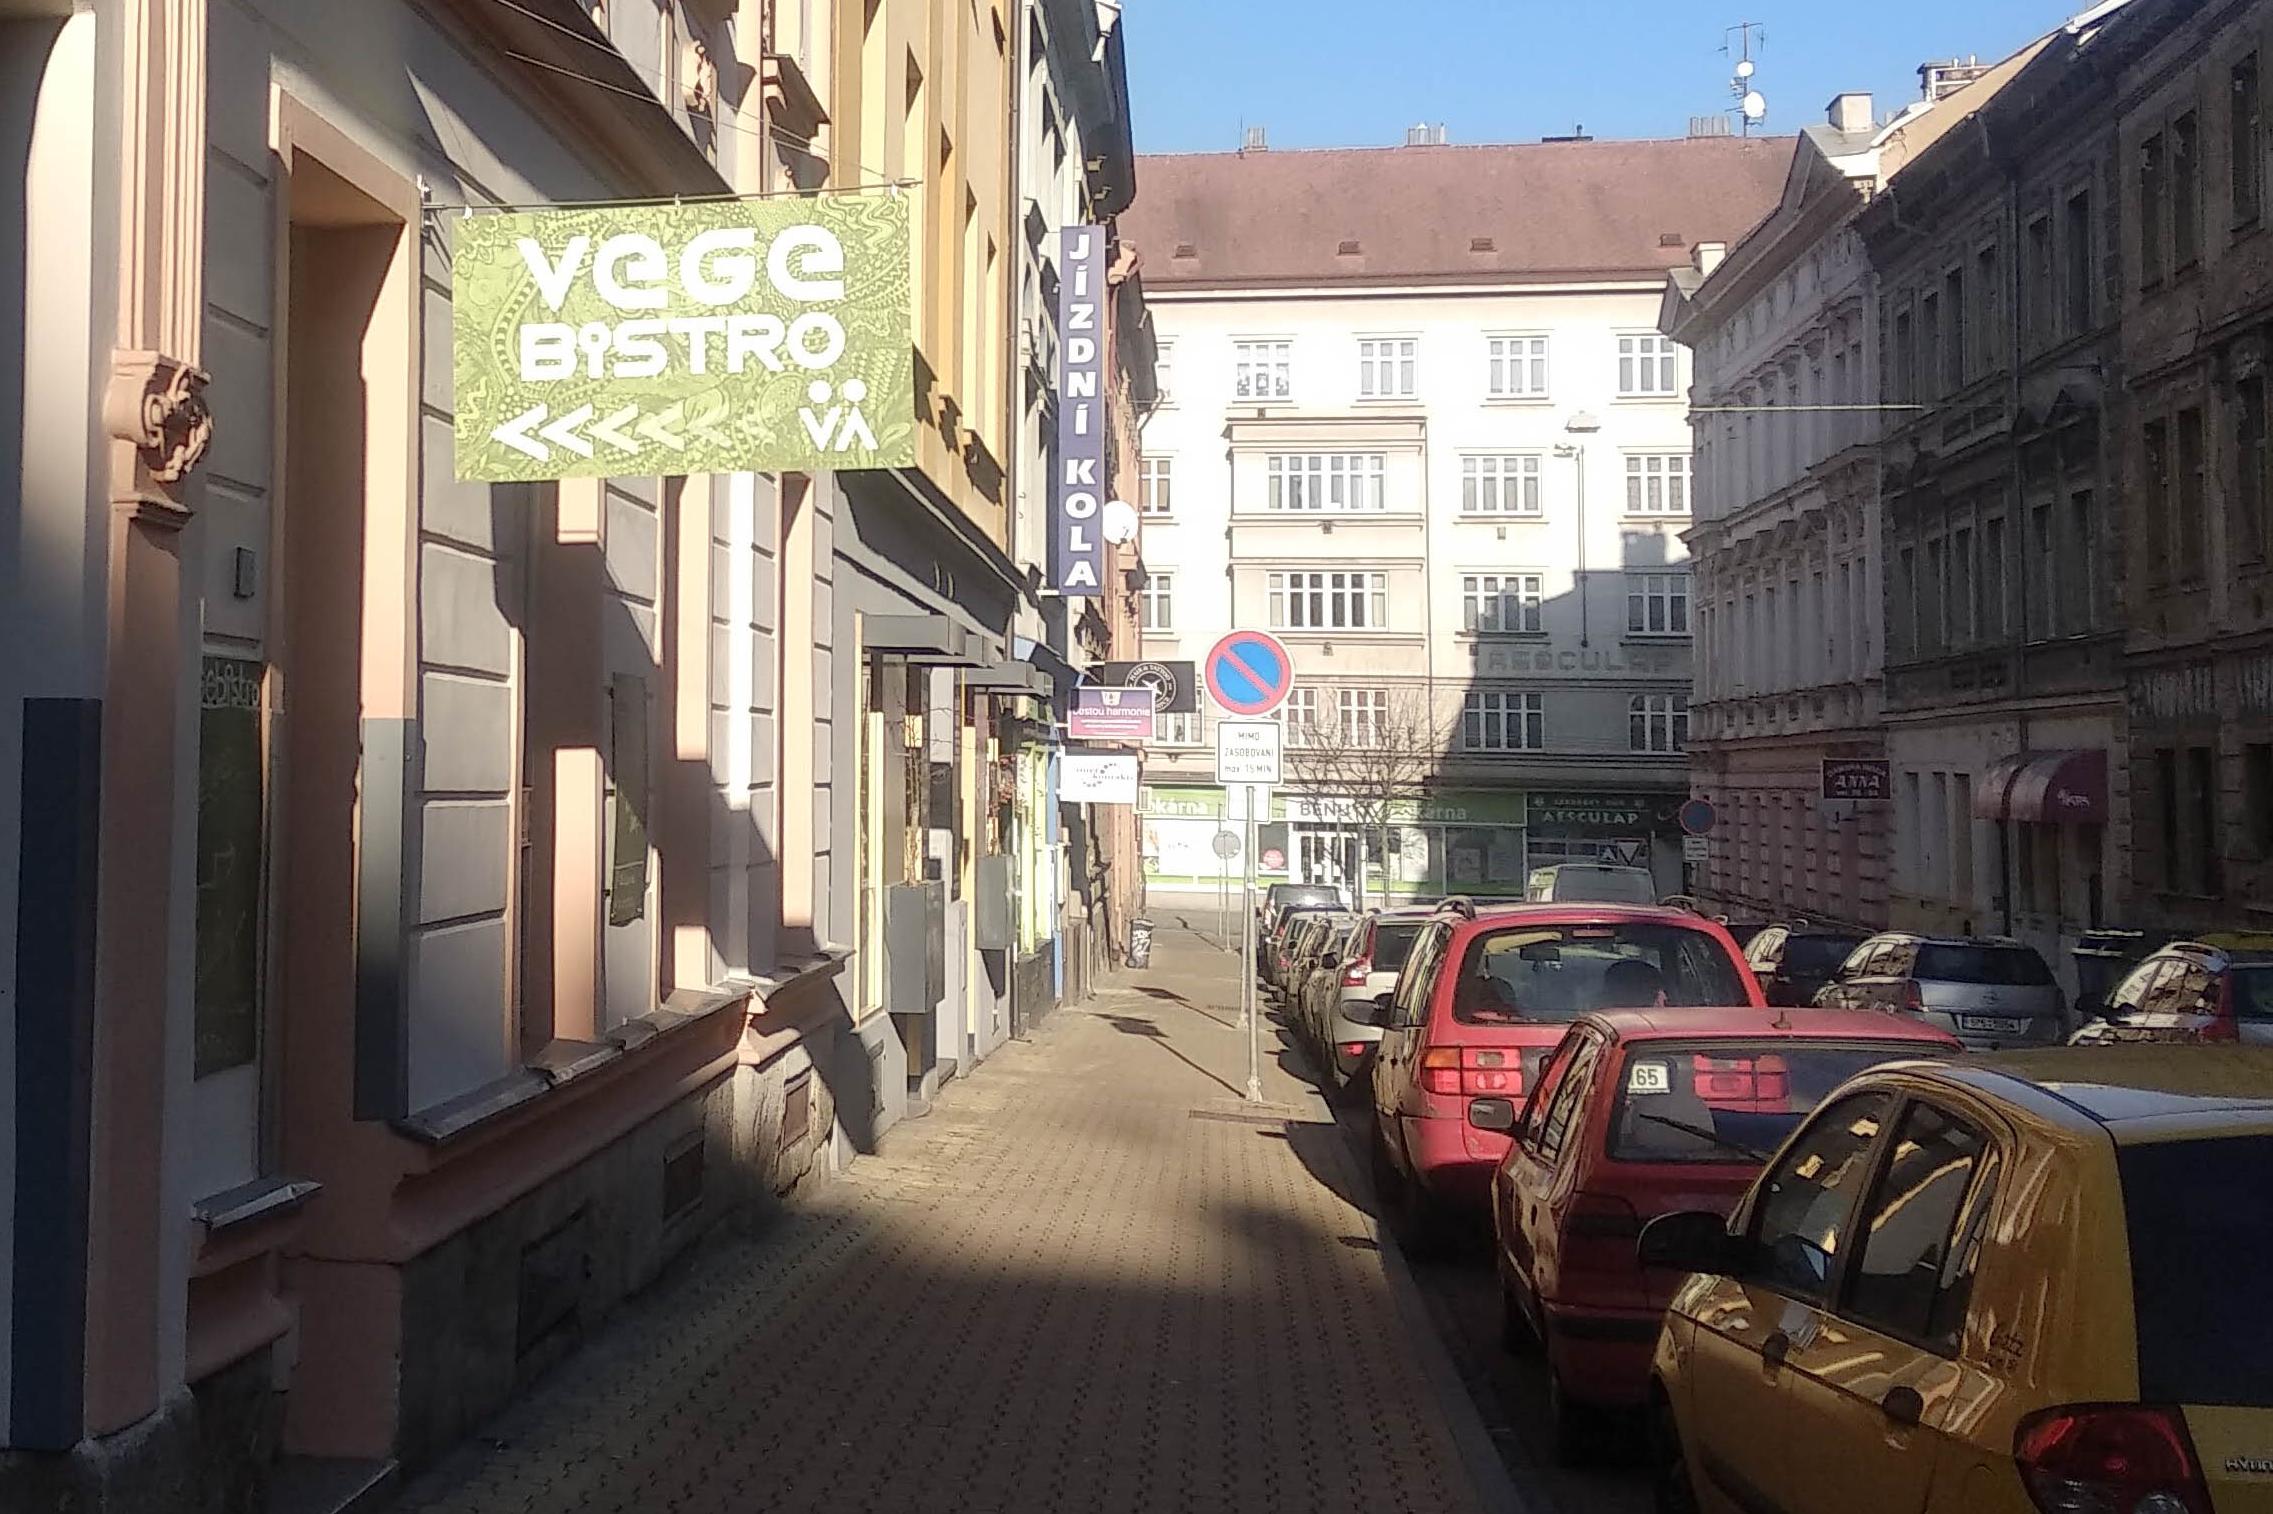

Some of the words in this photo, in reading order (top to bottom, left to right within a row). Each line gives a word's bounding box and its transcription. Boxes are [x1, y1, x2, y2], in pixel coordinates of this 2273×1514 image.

[1066, 233, 1097, 436] JÍZDNÍ
[1064, 458, 1098, 588] KOLA
[1238, 732, 1260, 741] MIMO
